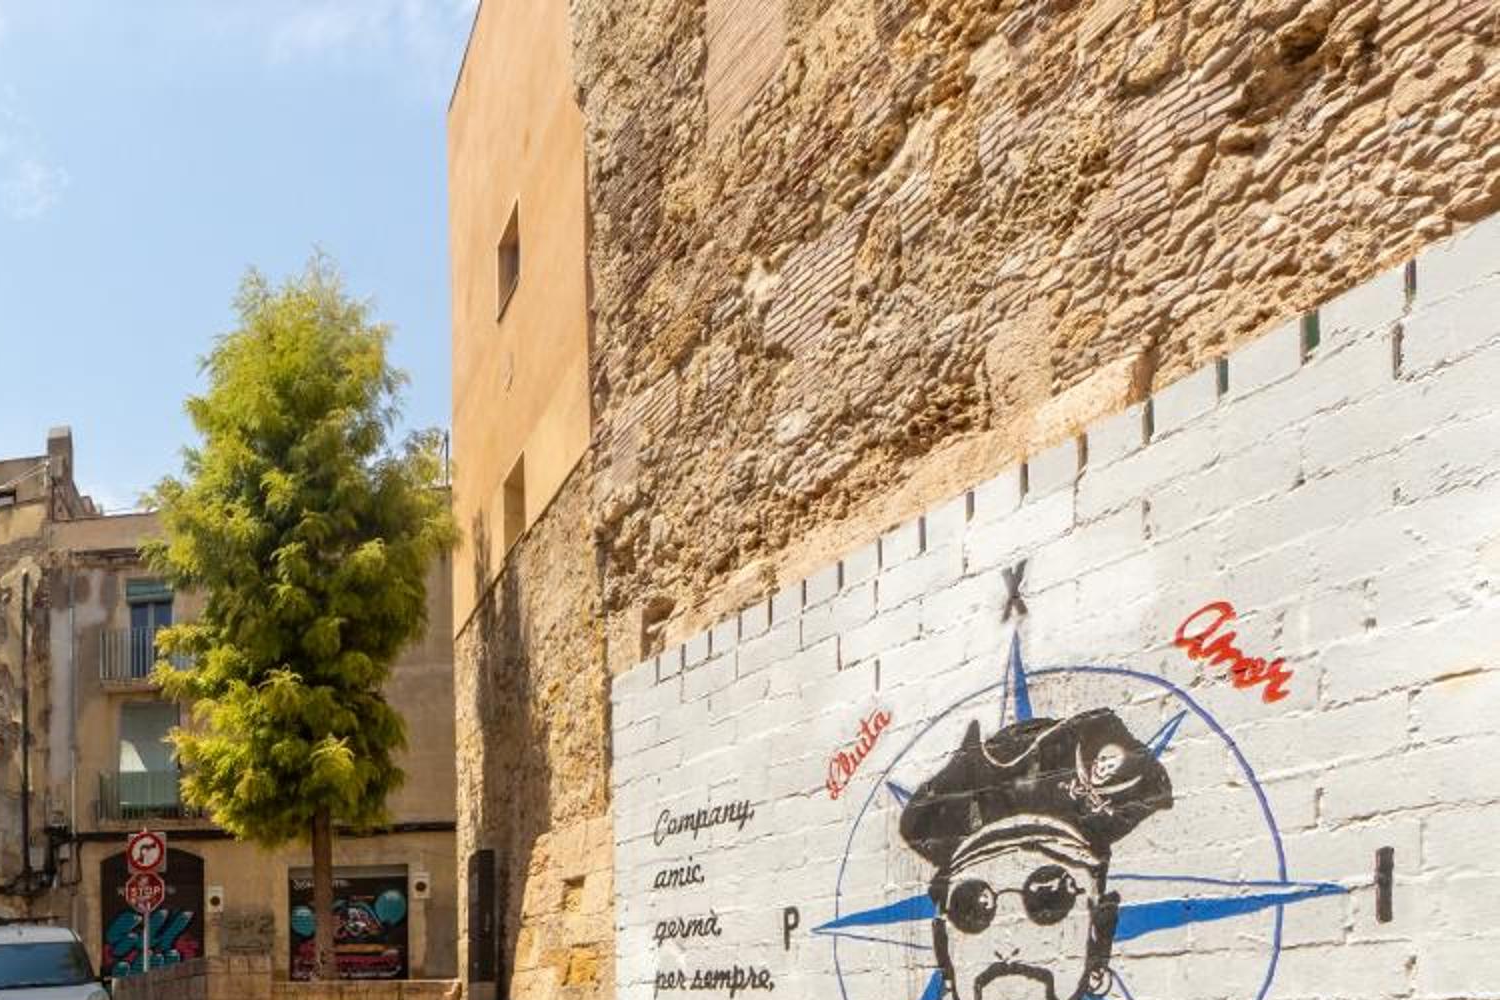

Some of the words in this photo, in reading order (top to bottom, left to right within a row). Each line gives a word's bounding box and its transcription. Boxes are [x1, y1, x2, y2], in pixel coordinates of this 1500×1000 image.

[1001, 559, 1028, 624] X
[653, 855, 705, 889] amic,
[131, 886, 161, 898] STOP
[783, 905, 800, 951] P
[654, 968, 687, 1000] per
[690, 965, 775, 1000] sempre,
